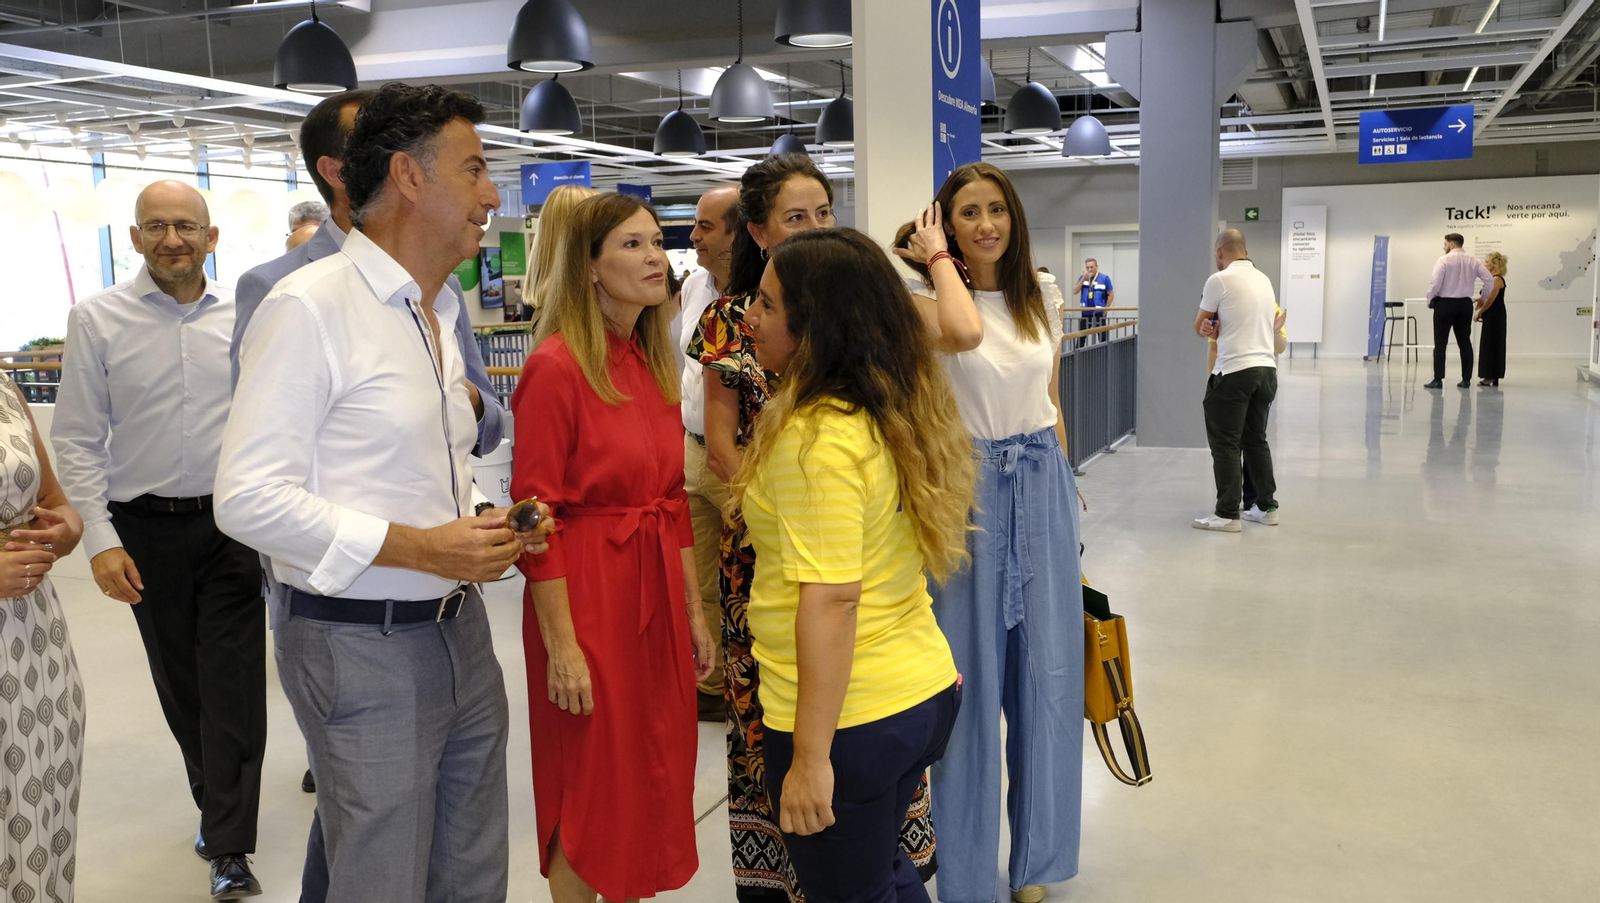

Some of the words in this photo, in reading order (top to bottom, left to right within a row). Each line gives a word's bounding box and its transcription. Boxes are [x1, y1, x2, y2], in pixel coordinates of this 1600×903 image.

[938, 90, 955, 106] Descubre
[964, 101, 977, 115] Almería
[1372, 126, 1412, 134] AUTOSERVICIO
[1525, 203, 1561, 211] encanta
[1531, 212, 1547, 220] por
[1548, 210, 1570, 219] aquí.
